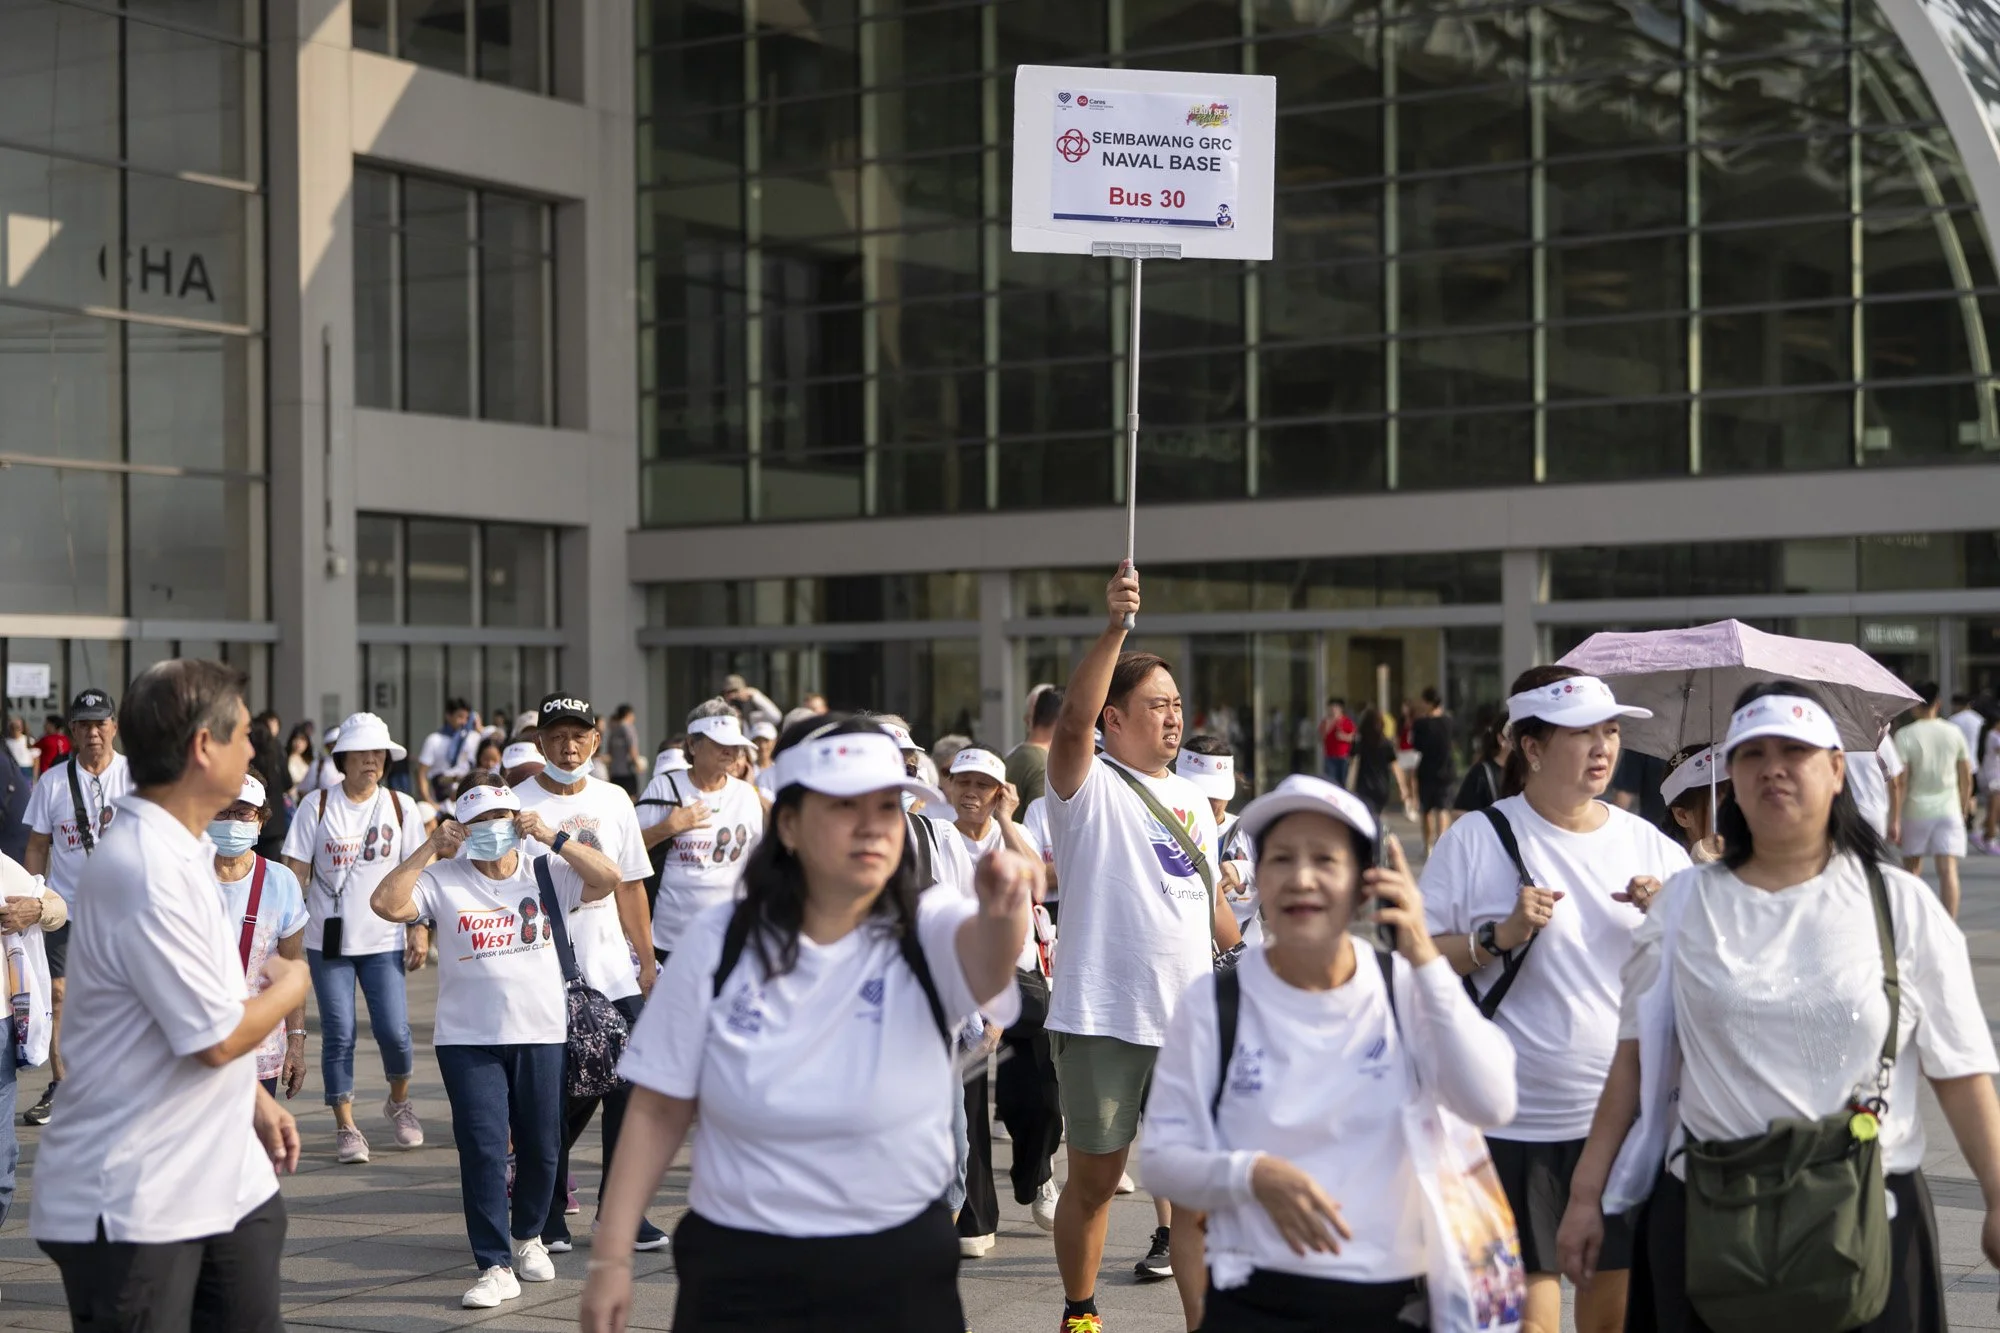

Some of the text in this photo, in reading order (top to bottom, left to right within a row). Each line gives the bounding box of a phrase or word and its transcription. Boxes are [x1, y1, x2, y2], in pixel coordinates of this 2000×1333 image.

[1092, 131, 1232, 151] SEMBAWANG GRC
[1102, 151, 1221, 172] NAVAL BASE
[1109, 186, 1186, 208] Bus 30
[543, 698, 590, 713] OAKLEY
[672, 838, 711, 850] NORTH
[458, 914, 515, 934] NORTH
[471, 931, 515, 951] WEST
[476, 950, 497, 960] BRISK
[498, 944, 531, 956] WALKING
